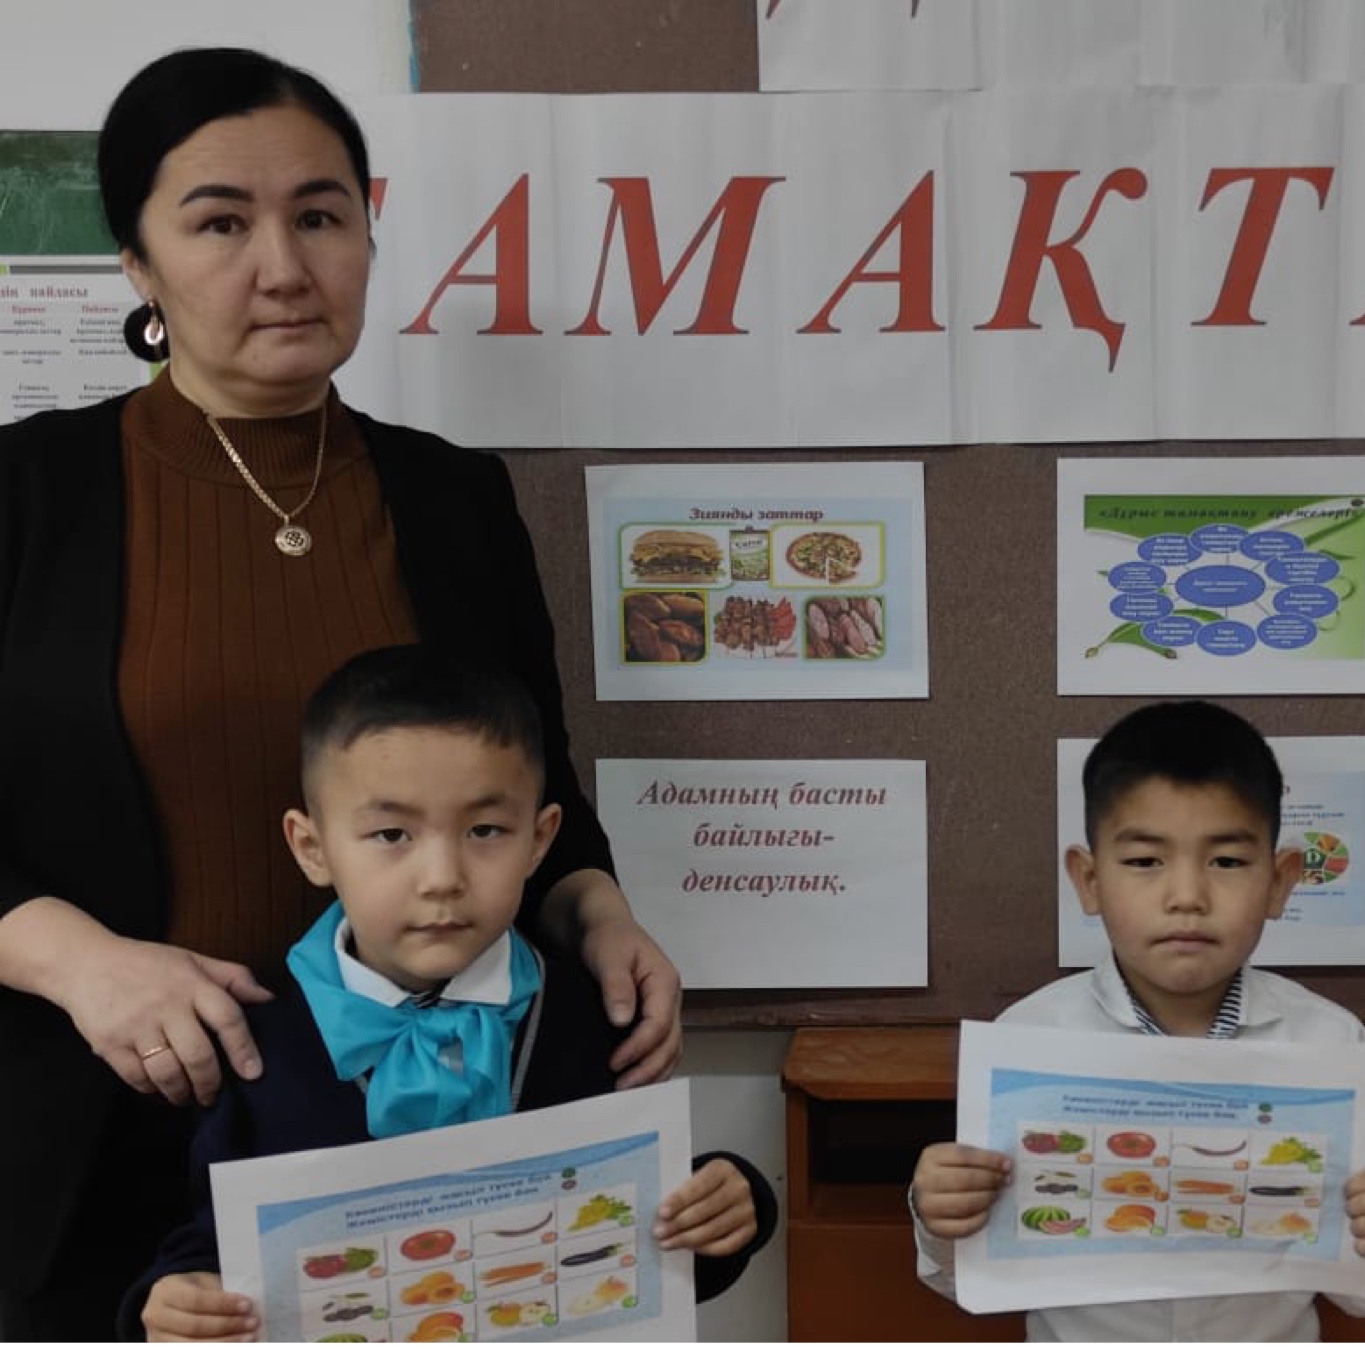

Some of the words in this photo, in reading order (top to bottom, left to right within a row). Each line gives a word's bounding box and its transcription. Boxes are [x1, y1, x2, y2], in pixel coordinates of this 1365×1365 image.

[636, 780, 778, 810] Адамның
[789, 782, 886, 806] басты
[682, 868, 847, 898] денсаулық.
